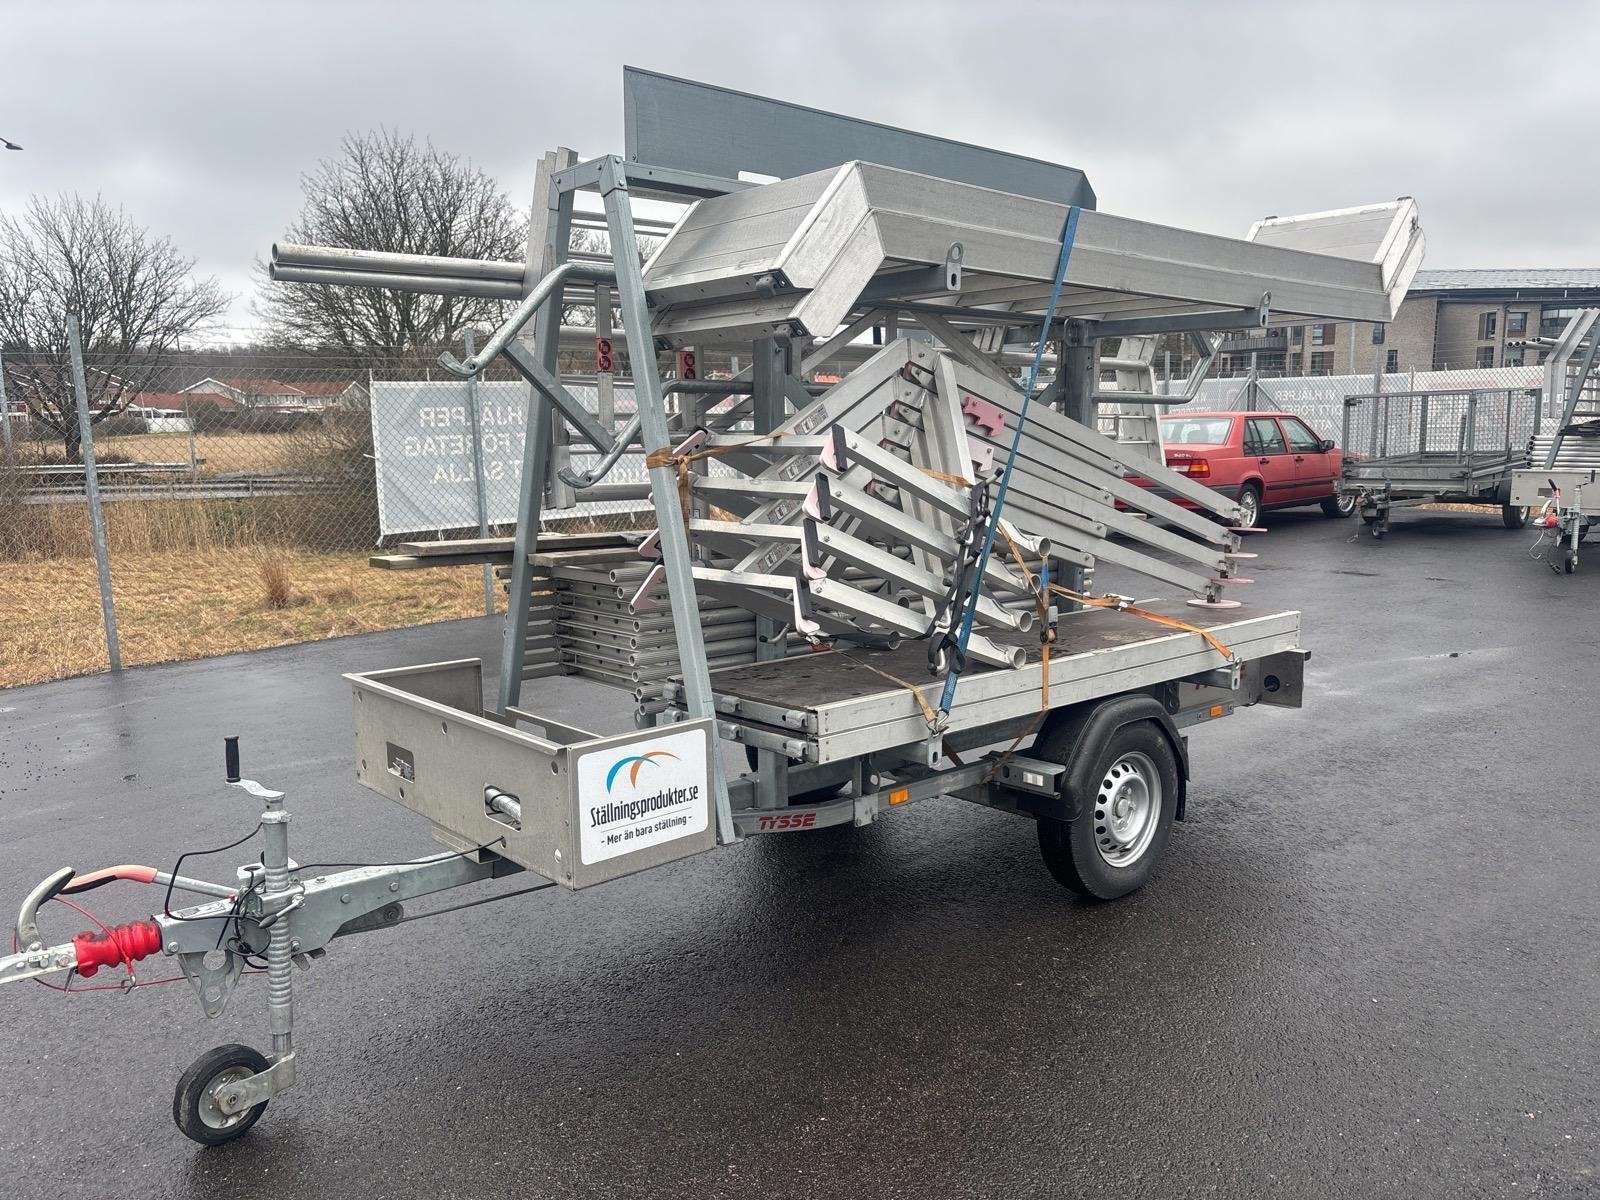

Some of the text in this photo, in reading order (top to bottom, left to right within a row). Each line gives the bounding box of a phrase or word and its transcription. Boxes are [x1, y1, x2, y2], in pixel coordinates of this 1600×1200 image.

[590, 785, 699, 828] Ställningsprodukter.se
[758, 812, 817, 831] TYSSE
[607, 834, 623, 845] Mer
[624, 829, 634, 840] än
[635, 824, 653, 837] bara
[654, 815, 687, 832] ställning
